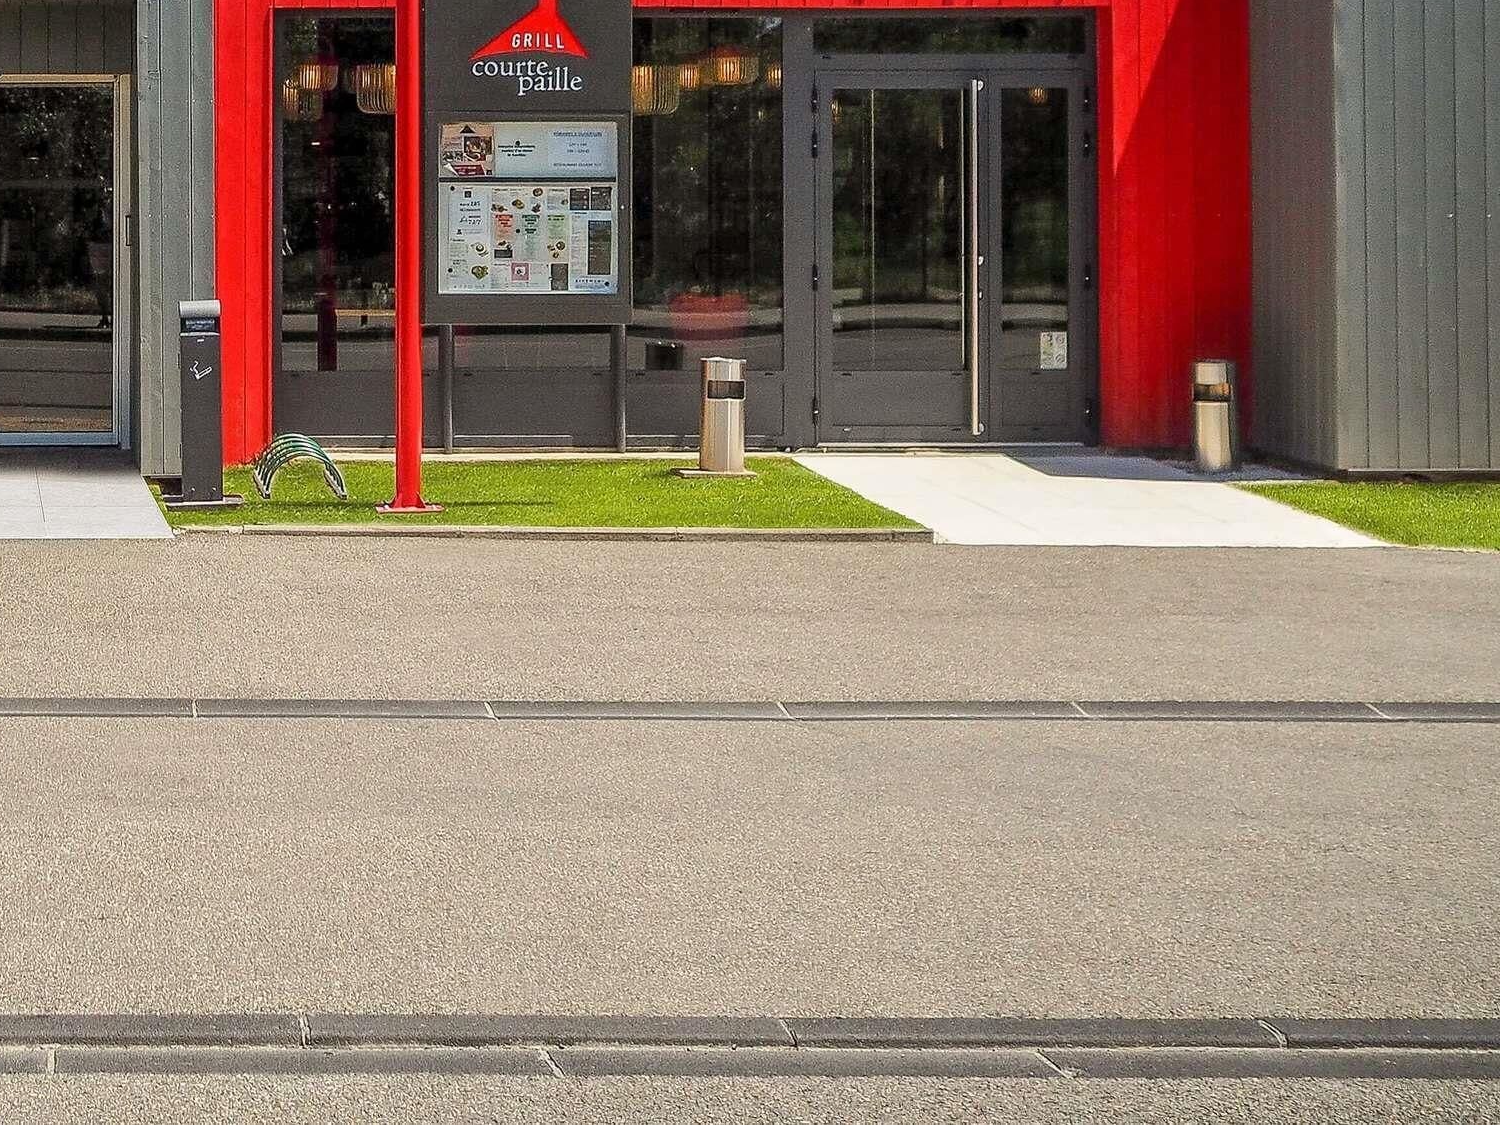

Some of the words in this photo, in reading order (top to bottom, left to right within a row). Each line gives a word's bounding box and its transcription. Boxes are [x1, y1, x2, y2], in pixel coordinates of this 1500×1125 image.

[511, 33, 565, 49] GRILL
[471, 59, 549, 77] courte
[517, 66, 583, 96] paille
